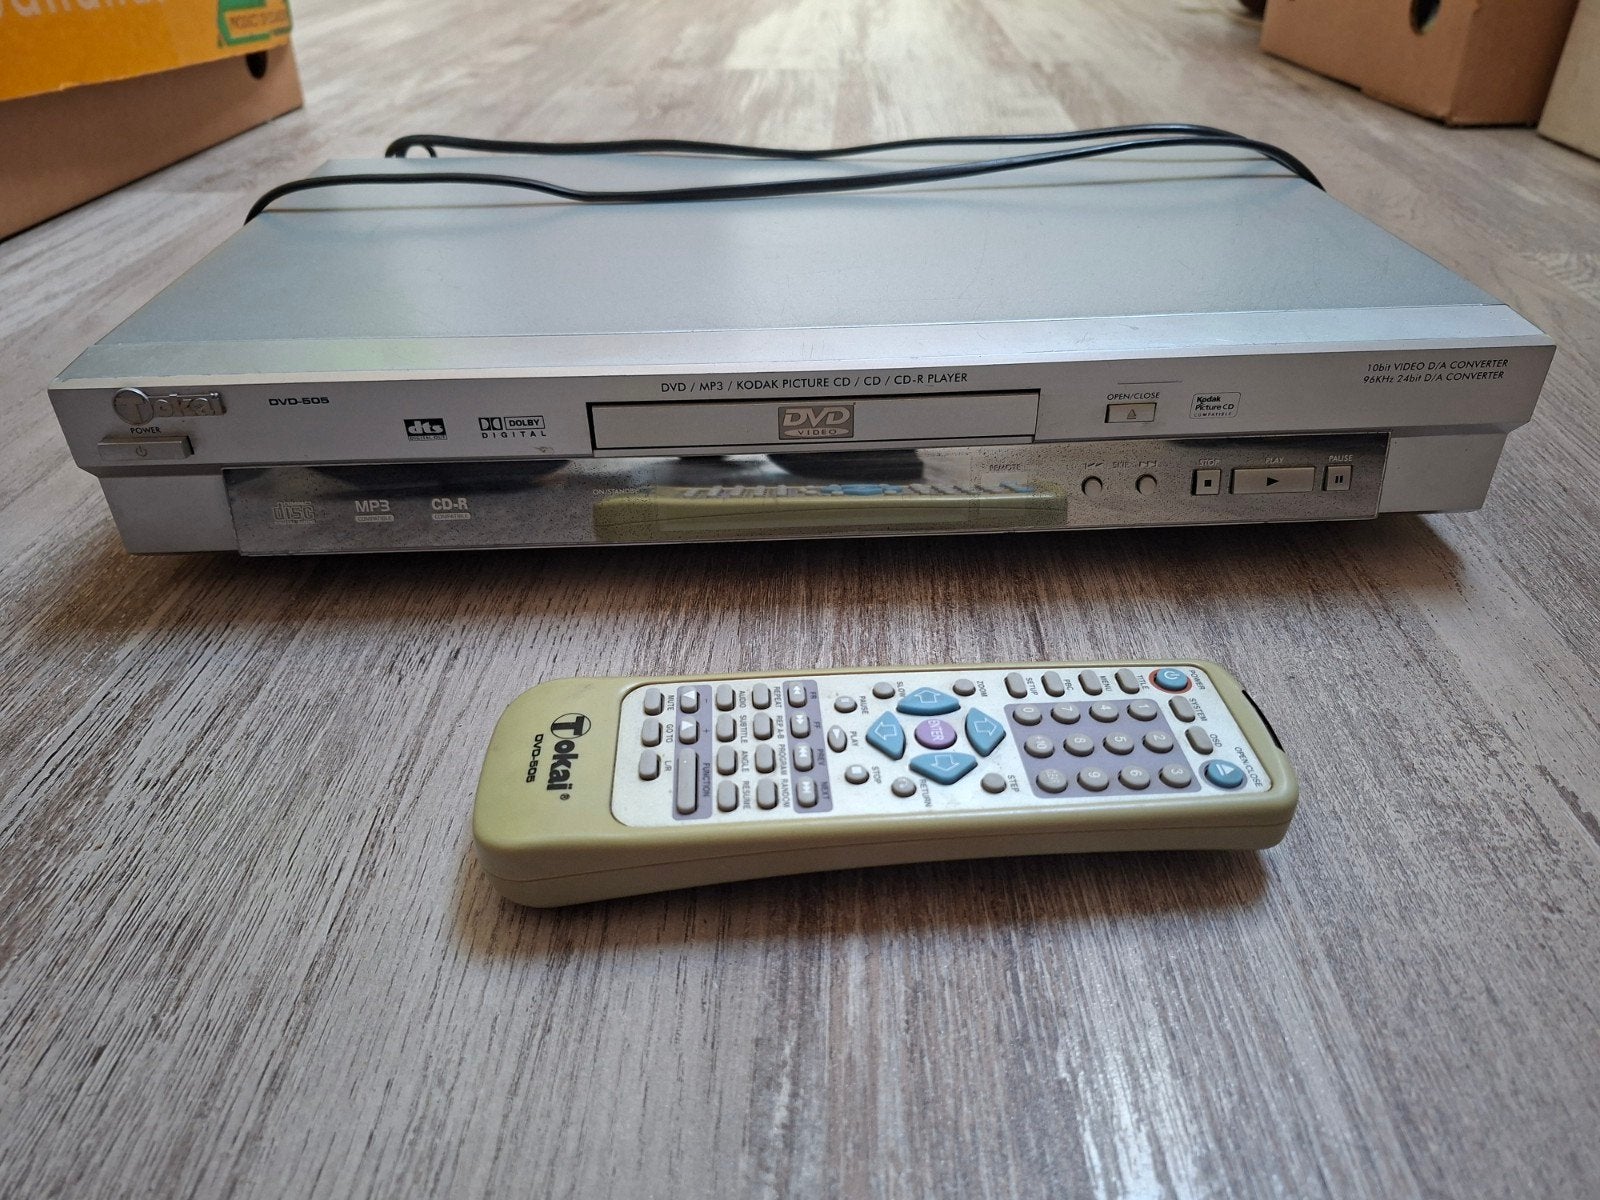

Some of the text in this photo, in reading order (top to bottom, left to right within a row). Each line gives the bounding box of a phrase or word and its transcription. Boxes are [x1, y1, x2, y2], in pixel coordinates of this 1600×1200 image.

[1367, 359, 1508, 372] 10bit VIDEO D/A CONVERTER
[661, 383, 686, 392] DVD
[699, 381, 723, 391] MP3
[737, 380, 779, 390] KODAK
[782, 378, 829, 388] PICTURE
[834, 377, 851, 387] CD
[863, 376, 881, 386] CD
[894, 375, 924, 385] CD-R
[927, 373, 968, 384] PLAYER
[1363, 371, 1505, 384] 96KHz 24bit D/A CONVERTER
[269, 396, 330, 406] DVD-505
[1107, 392, 1160, 400] OPEN/CLOSE
[509, 419, 540, 427] DOLBY
[783, 407, 850, 426] DVD
[407, 420, 445, 435] dts
[355, 500, 390, 512] MP3
[431, 498, 468, 510] CD-R
[896, 681, 906, 698] SLOW
[976, 680, 988, 698] ZOOM
[1026, 677, 1038, 696] SETUP
[1100, 675, 1112, 692] MENU
[1137, 675, 1149, 690] TITLE
[1189, 669, 1206, 691] POWER
[667, 694, 675, 711] MUTE
[774, 686, 782, 708] REPEAT
[810, 691, 817, 700] FR
[859, 695, 870, 715] PAUSE
[1188, 697, 1208, 722] SYSTEM
[739, 715, 748, 744] SUBTITLE
[813, 721, 821, 729] FF
[928, 718, 945, 742] ENTER
[850, 731, 859, 747] PLAY
[1210, 733, 1222, 748] OSD
[526, 734, 544, 783] DVD-505
[547, 713, 591, 790] Tokai
[779, 744, 788, 776] PROGRAM
[817, 748, 826, 766] PREV
[664, 760, 672, 772] L/R
[741, 751, 750, 773] ANGLE
[1234, 746, 1263, 787] OPEN/CLOSE
[702, 763, 711, 797] FUNCTION
[871, 765, 882, 784] STOP
[1007, 774, 1020, 793] STEP
[742, 780, 751, 810] RESUME
[781, 778, 791, 808] RANDOM
[821, 781, 830, 800] NEXT
[919, 778, 932, 808] RETURN
